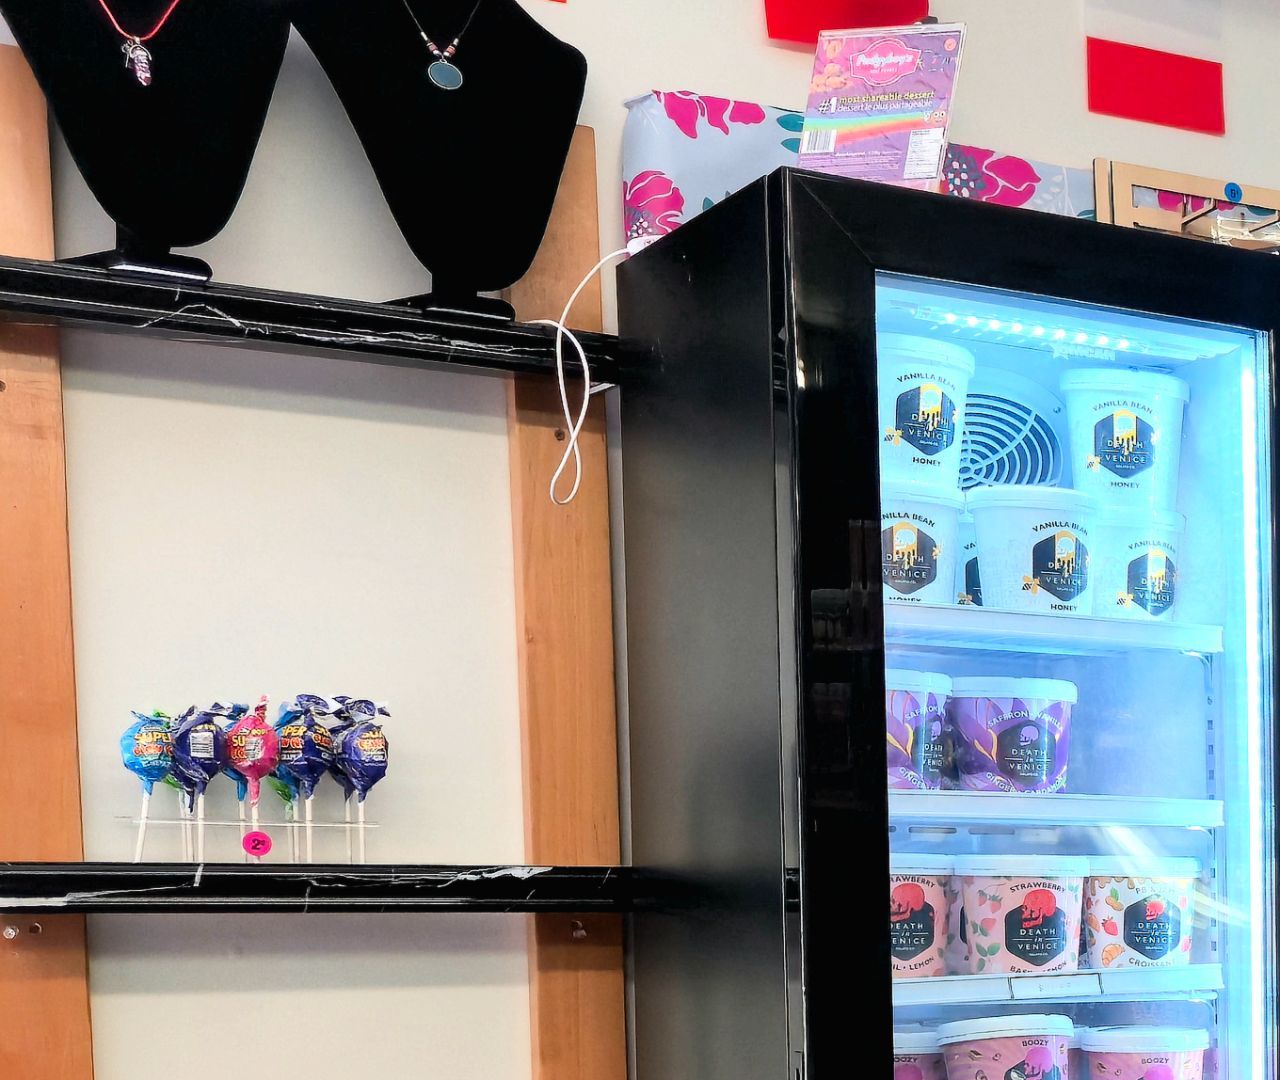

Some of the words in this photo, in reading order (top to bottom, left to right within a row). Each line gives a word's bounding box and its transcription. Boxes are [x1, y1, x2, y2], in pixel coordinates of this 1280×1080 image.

[897, 373, 935, 382] VANILLA
[1092, 400, 1128, 412] VANILLA
[913, 457, 940, 466] HONEY
[1105, 454, 1146, 463] VENICE
[913, 514, 935, 527] BEAN
[1032, 521, 1069, 532] VANILLA
[886, 554, 924, 563] DEATH
[883, 569, 927, 578] VENICE
[1051, 603, 1078, 611] HONEY
[1010, 882, 1066, 893] STRAWBERRY
[892, 937, 925, 945] ENICE
[909, 957, 934, 971] LEMON
[1022, 1039, 1049, 1047] BOOZY
